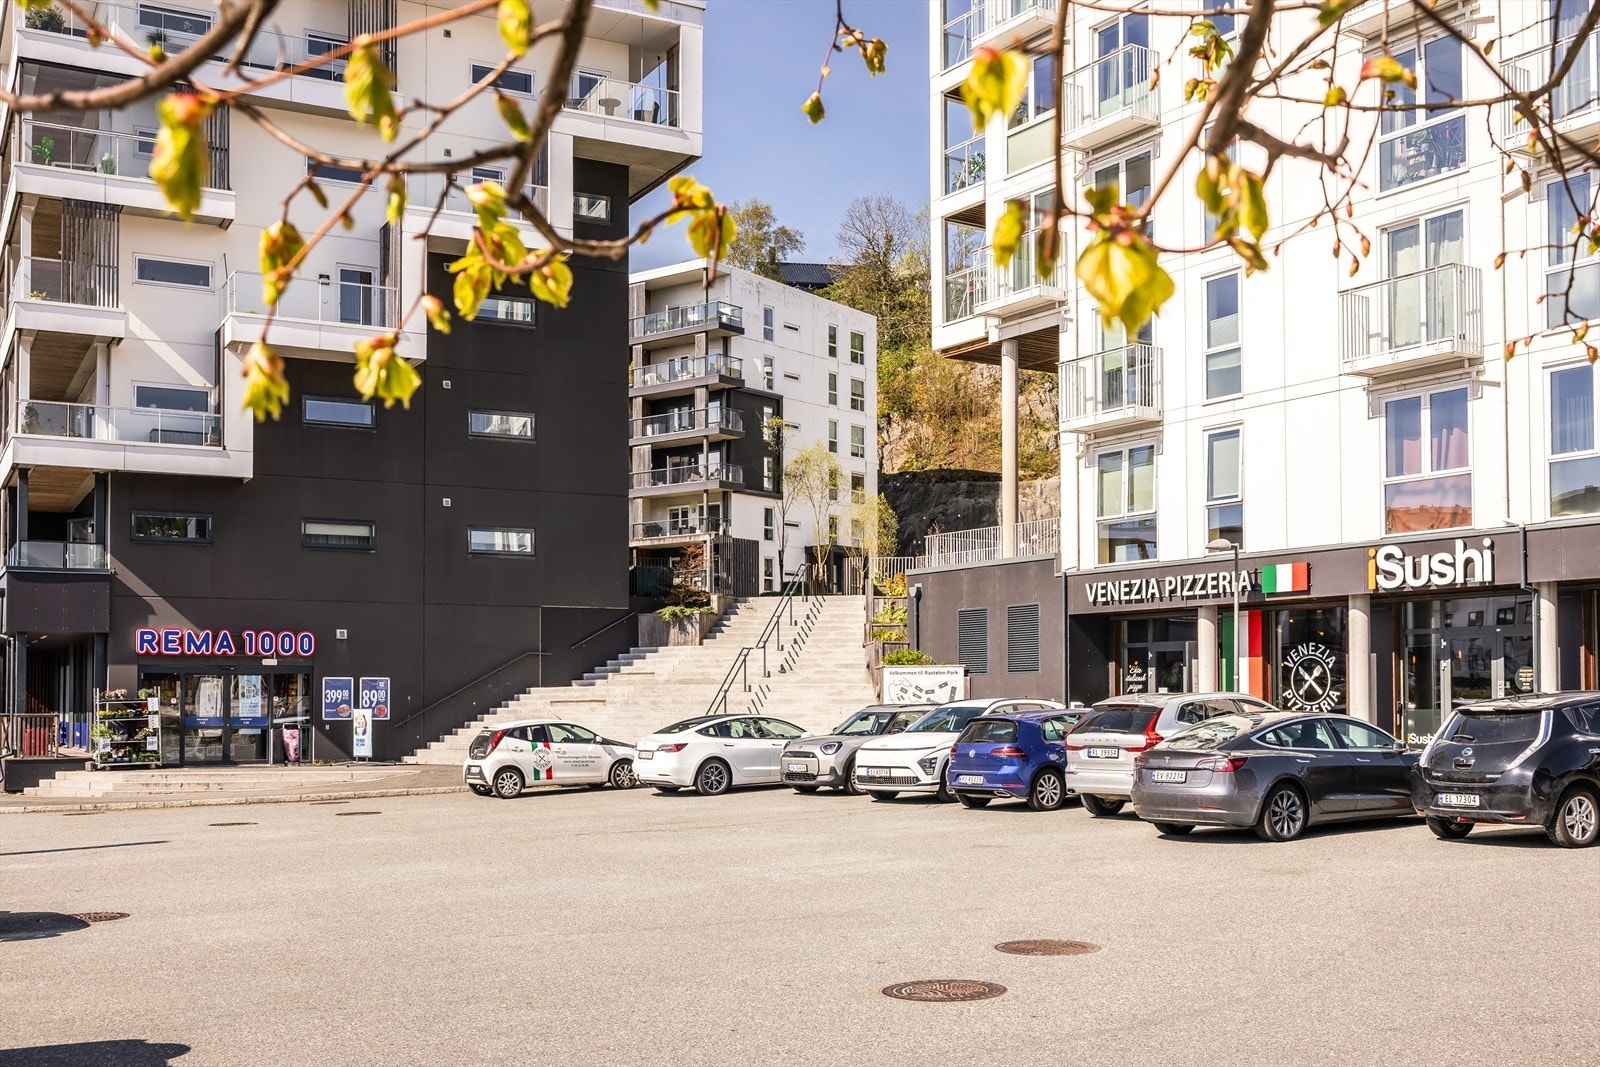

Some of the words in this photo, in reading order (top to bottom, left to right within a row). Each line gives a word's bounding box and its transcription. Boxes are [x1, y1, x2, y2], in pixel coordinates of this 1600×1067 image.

[1368, 537, 1492, 589] iSushi
[1085, 577, 1160, 602] VENEZIA
[1165, 569, 1251, 597] PIZZERIA
[136, 628, 235, 656] REMA
[242, 630, 316, 656] 1000
[1284, 642, 1336, 669] VENEZIA
[325, 689, 342, 703] 399
[362, 690, 378, 708] 89
[378, 689, 386, 699] 00
[1282, 690, 1341, 713] PIZZERIA
[1407, 732, 1436, 746] iSush
[1156, 771, 1164, 779] EV
[1165, 771, 1184, 780] 82214
[1445, 794, 1453, 803] EL
[1455, 795, 1477, 804] 17304
